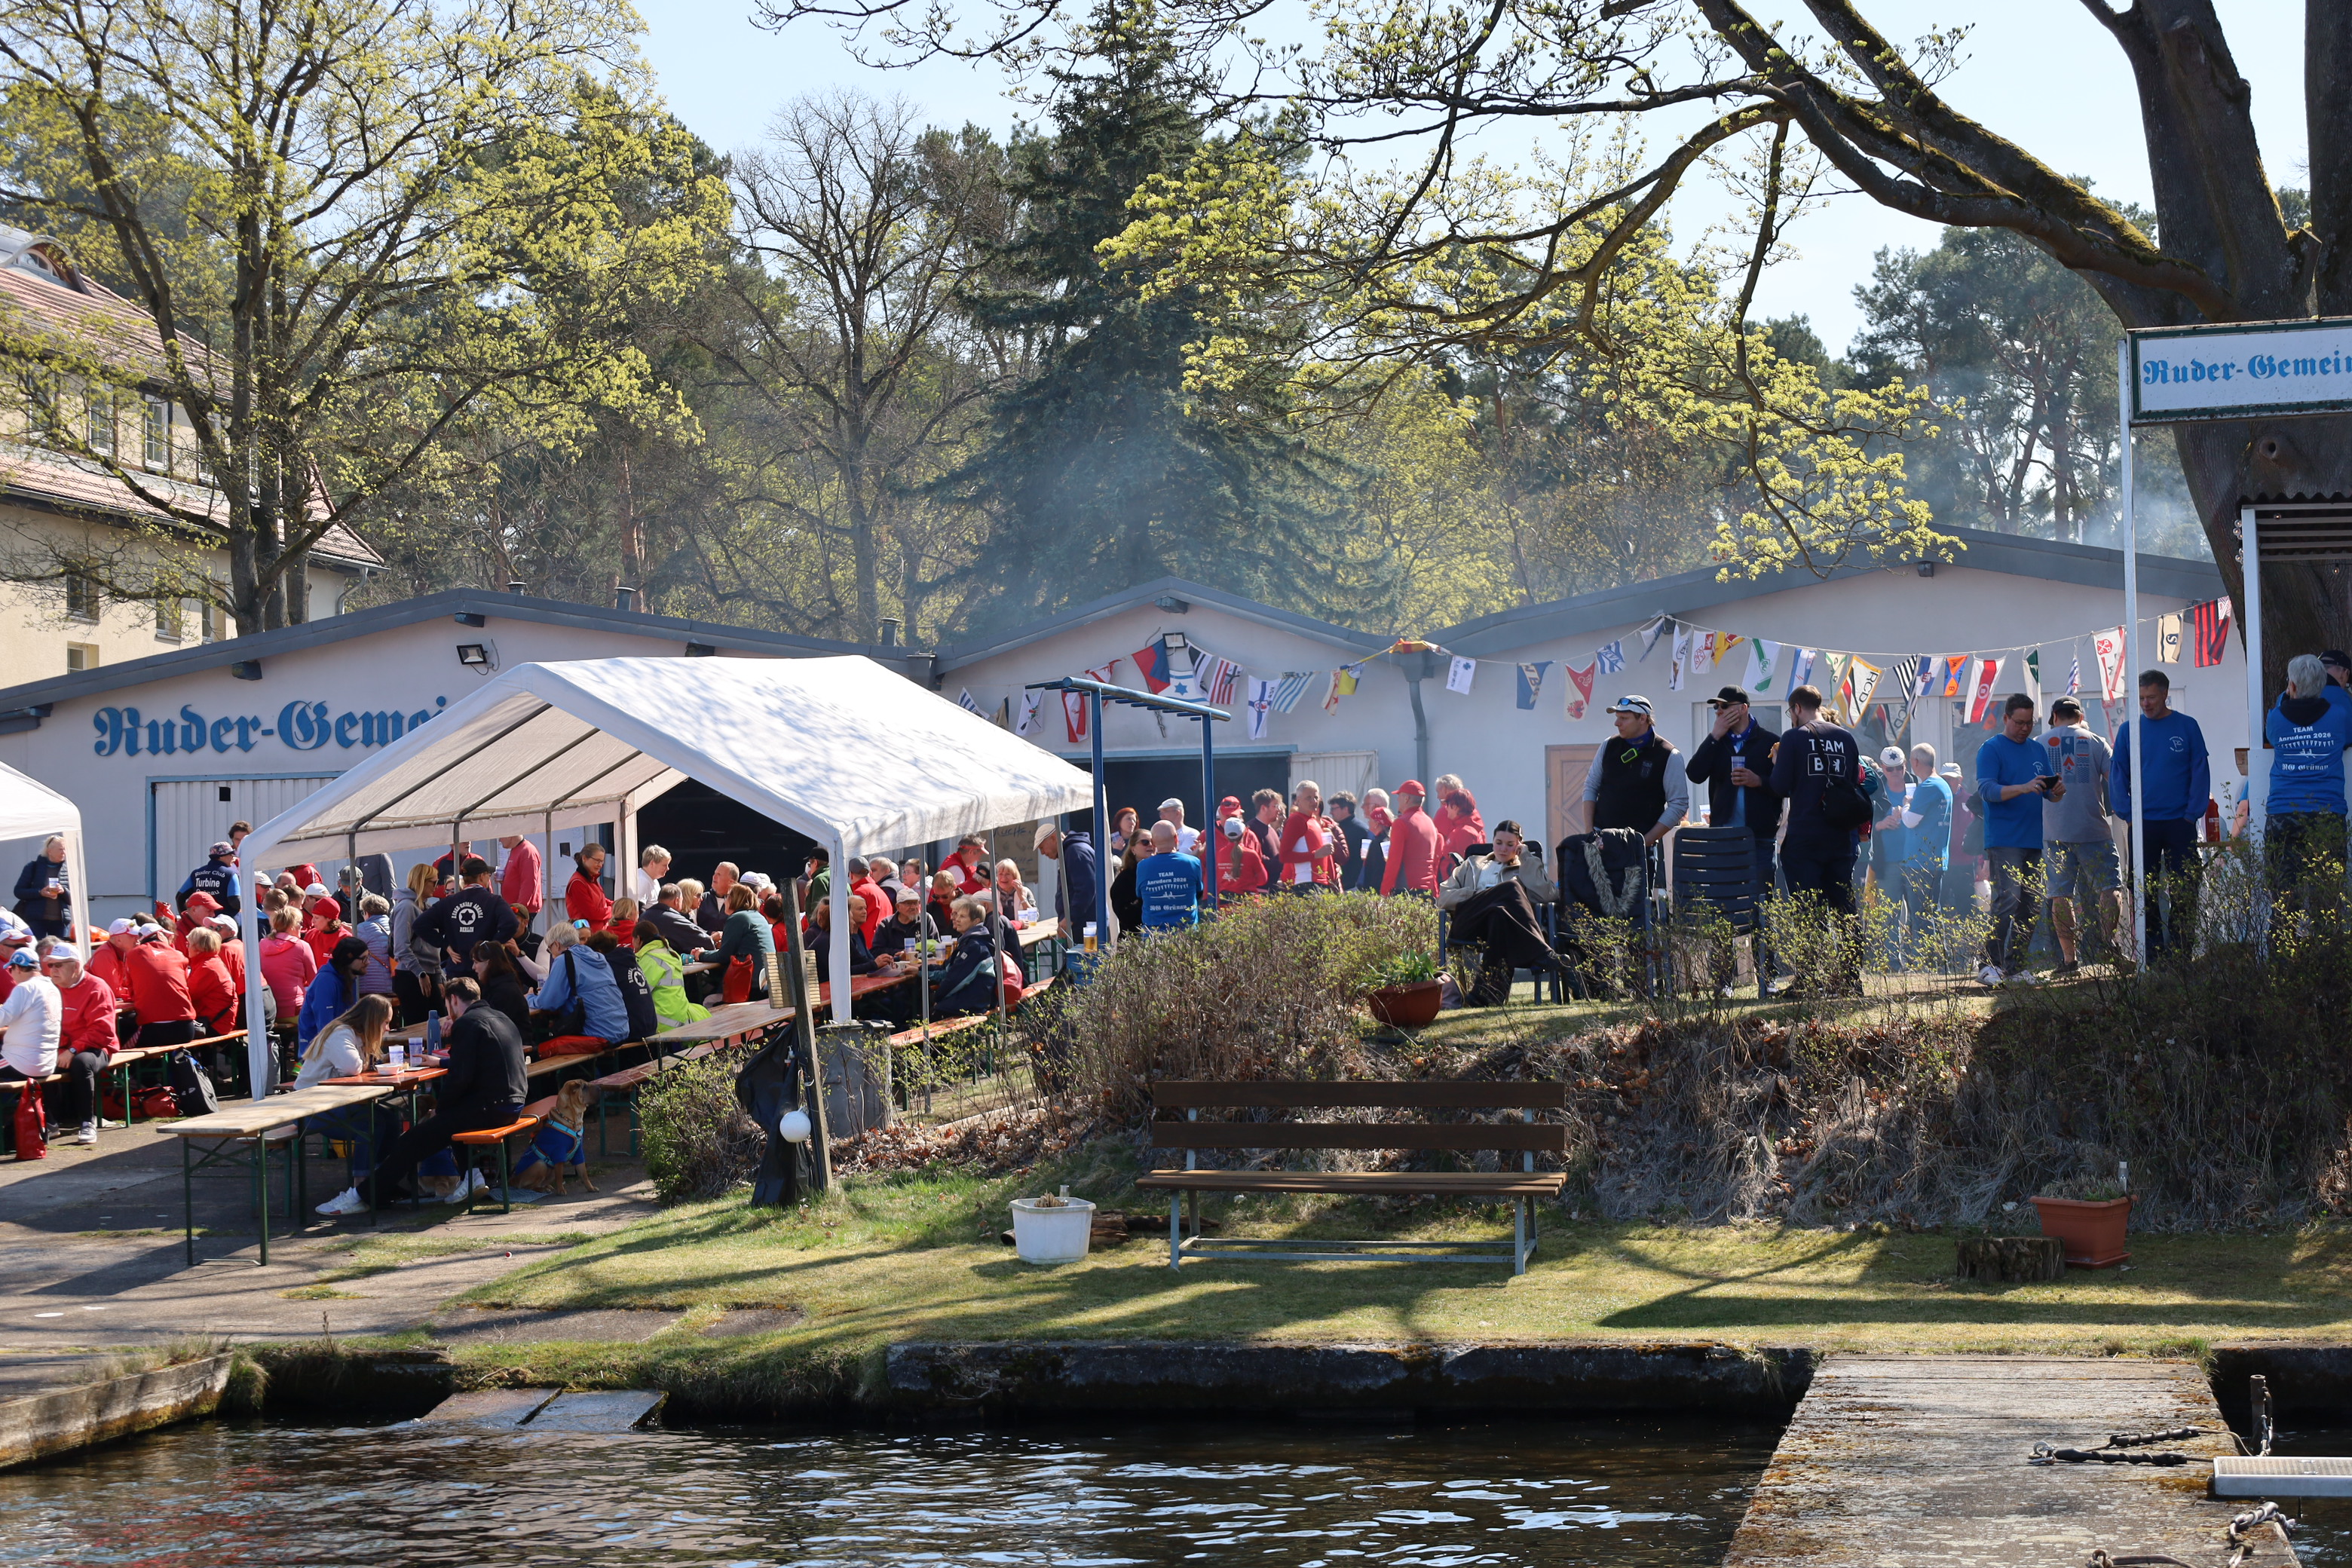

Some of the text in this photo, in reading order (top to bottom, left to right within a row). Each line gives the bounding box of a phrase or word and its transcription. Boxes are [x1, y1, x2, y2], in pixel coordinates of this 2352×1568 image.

[1859, 671, 1879, 703] RCD
[93, 696, 446, 756] Ruder-Geme
[1814, 757, 1824, 771] B
[212, 870, 225, 878] Club
[196, 877, 220, 888] Turbine
